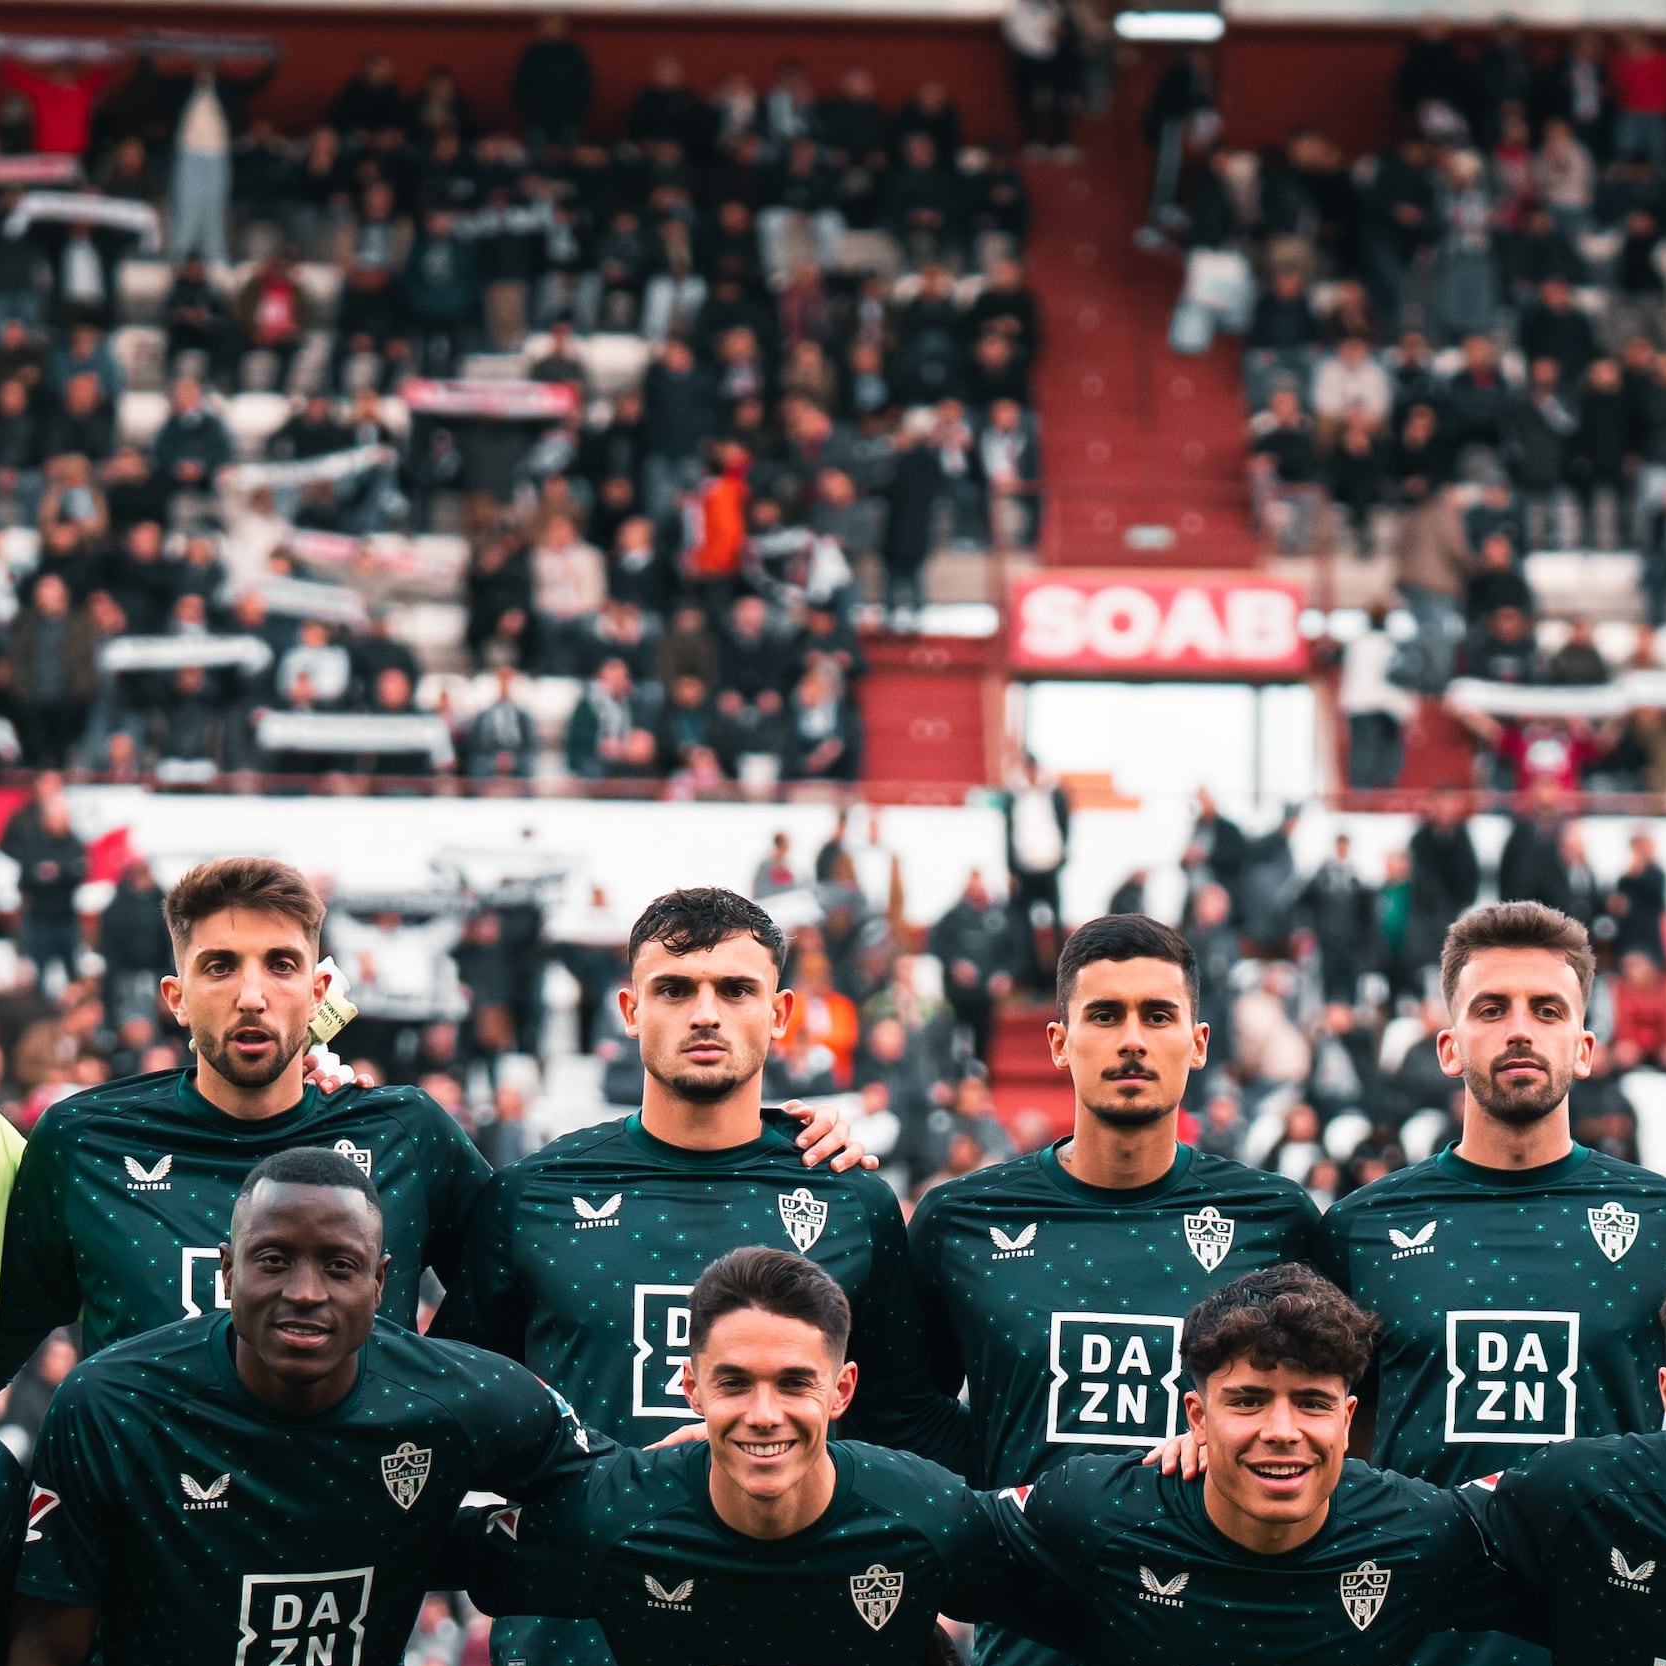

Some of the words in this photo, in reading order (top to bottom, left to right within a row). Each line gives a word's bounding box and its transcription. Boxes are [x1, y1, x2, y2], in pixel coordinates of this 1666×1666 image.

[1019, 586, 1298, 658] SOAB
[575, 1219, 619, 1229] CASTORE
[785, 1212, 821, 1225] ALMERIA
[1595, 1224, 1632, 1234] ALMERIA
[1190, 1232, 1228, 1243] ALMERIA
[992, 1249, 1035, 1260] CASTORE
[1392, 1246, 1434, 1260] CASTORE
[667, 1307, 692, 1347] D
[1081, 1334, 1153, 1375] DA
[1478, 1332, 1549, 1373] DA
[1079, 1382, 1147, 1424] ZN
[1477, 1380, 1545, 1421] ZN
[388, 1468, 425, 1480] ALMERIA
[183, 1501, 228, 1509] CASTORE
[1608, 1576, 1651, 1594] CASTORE
[857, 1590, 897, 1599] ALMERIA
[1345, 1588, 1382, 1596] ALMERIA
[647, 1601, 692, 1611] CASTORE
[1139, 1593, 1184, 1608] CASTORE
[272, 1591, 340, 1631] DA
